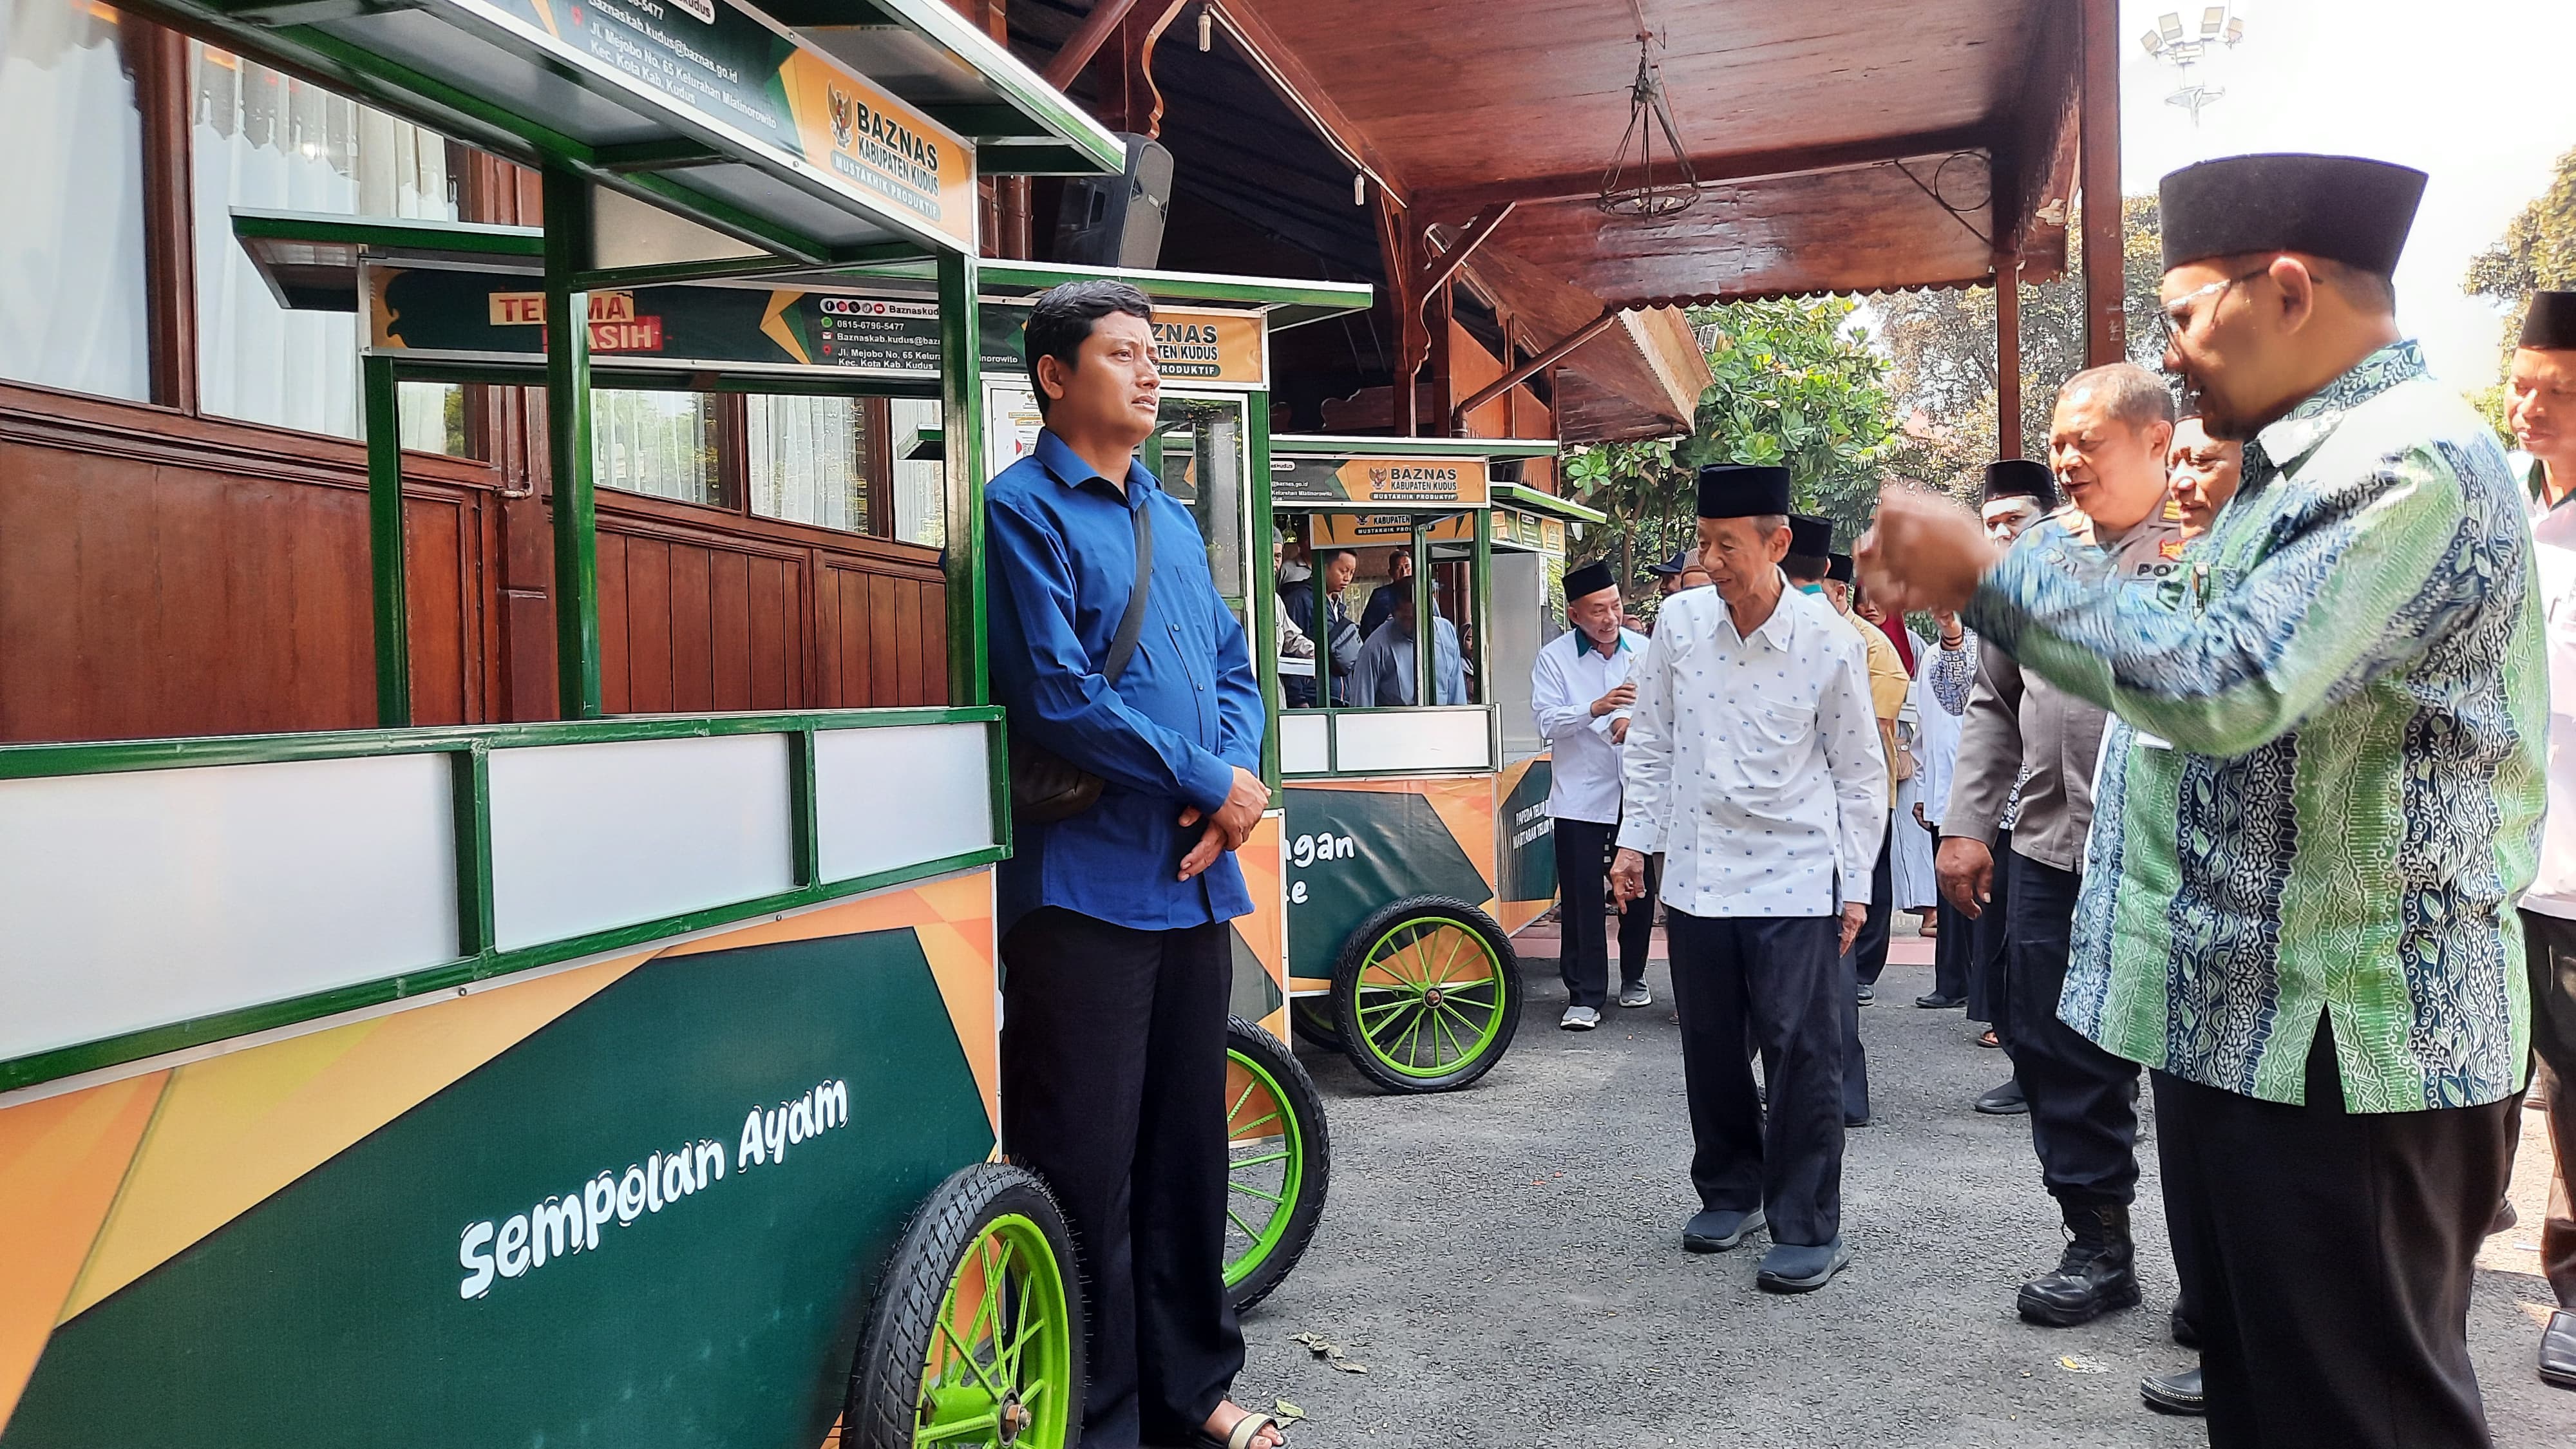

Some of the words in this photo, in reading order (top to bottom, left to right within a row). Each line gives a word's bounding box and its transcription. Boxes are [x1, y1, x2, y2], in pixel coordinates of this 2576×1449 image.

[590, 40, 615, 64] Kec.
[616, 53, 641, 77] Kota
[641, 65, 665, 90] Kab.
[665, 77, 697, 106] Kudus
[604, 29, 643, 60] Mejobo
[643, 49, 661, 70] No.
[662, 59, 675, 77] 65
[676, 65, 721, 102] Kelurahan
[857, 101, 939, 172] BAZNAS
[858, 135, 909, 182] KABUPATEN
[910, 164, 939, 198] KUDUS
[835, 155, 889, 193] MUSTAKHIK
[890, 184, 938, 218] PRODUKTIF
[889, 306, 939, 316] Baznaskud
[1151, 323, 1217, 344] ZNAS
[838, 348, 849, 357] Jl.
[851, 349, 884, 359] Mejobo
[1180, 345, 1218, 361] KUDUS
[838, 358, 858, 366] Kec.
[860, 359, 881, 368] Kota
[883, 360, 903, 368] Kab.
[905, 361, 934, 370] Kudus
[1390, 468, 1457, 480] BAZNAS
[1391, 481, 1432, 491] KABUPATEN
[1433, 482, 1457, 491] KUDUS
[1373, 515, 1410, 525] KABUPATEN
[2137, 563, 2180, 577] PO
[460, 1139, 726, 1300] Sempolan
[737, 1079, 849, 1173] Ayam
